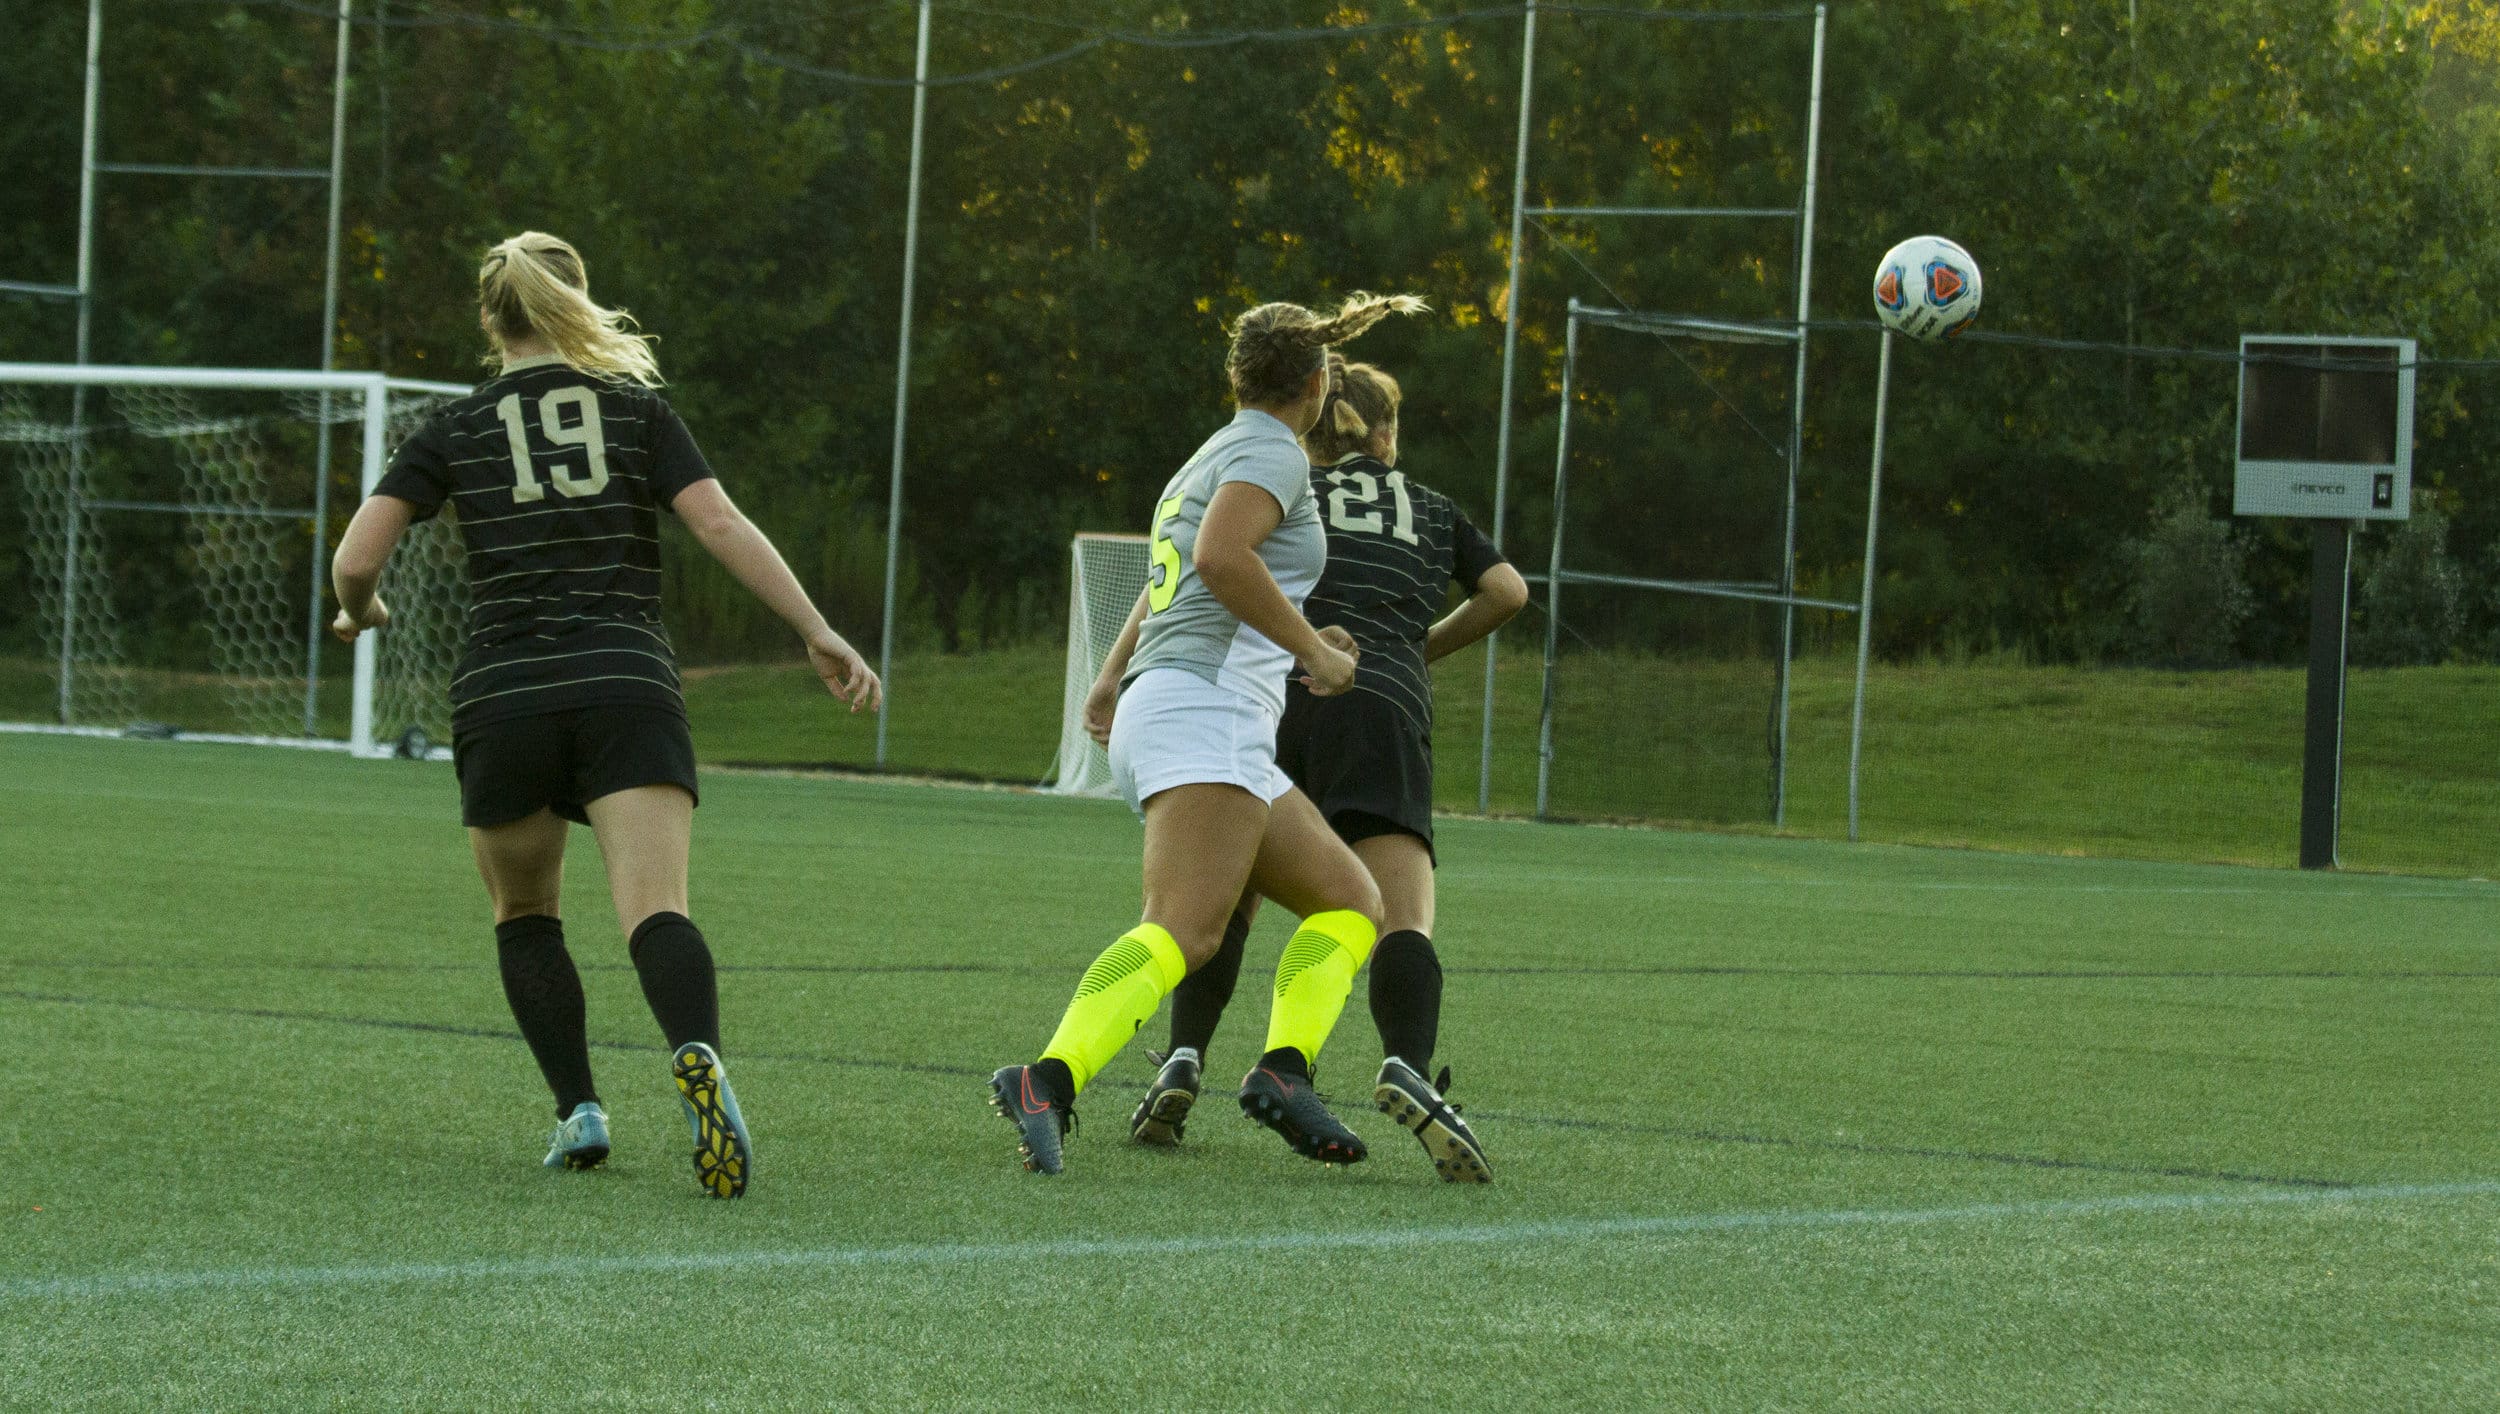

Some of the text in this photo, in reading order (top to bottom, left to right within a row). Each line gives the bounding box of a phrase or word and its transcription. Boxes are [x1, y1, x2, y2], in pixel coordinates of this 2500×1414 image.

[496, 385, 610, 504] 19
[1149, 490, 1185, 615] 5
[1325, 470, 1419, 547] 21
